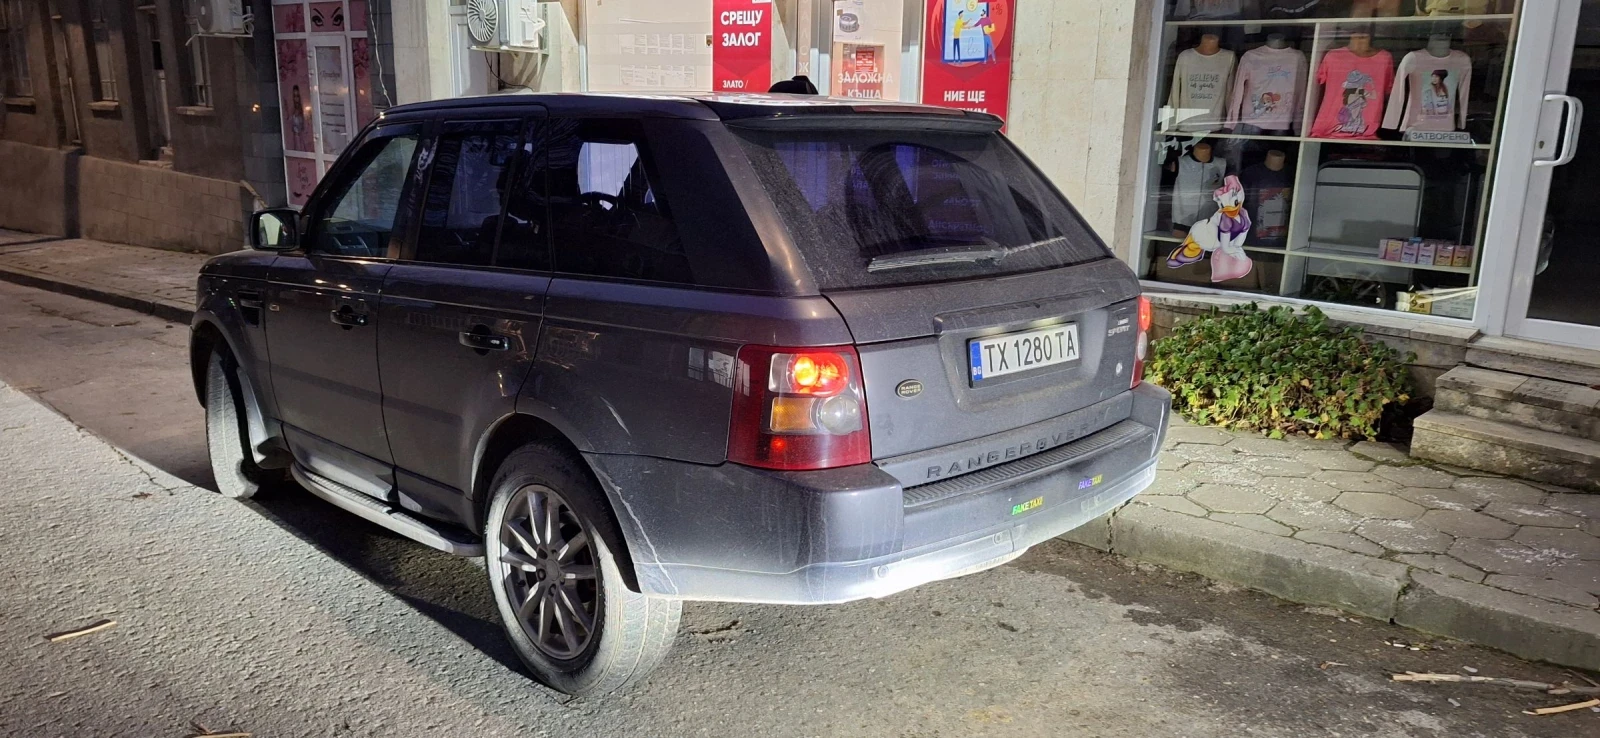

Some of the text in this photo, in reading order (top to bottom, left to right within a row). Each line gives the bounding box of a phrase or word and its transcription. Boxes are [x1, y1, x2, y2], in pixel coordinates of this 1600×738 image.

[720, 9, 763, 27] СРЕЩУ
[721, 32, 762, 47] ЗАЛОГ
[837, 71, 893, 84] ЗАЛОЖНА
[722, 80, 744, 89] ЗЛАТО
[943, 90, 986, 104] НИЕ ЩЕ
[1411, 131, 1470, 142] ЗАТВОРЕНО
[984, 330, 1076, 373] TX 1280 TA
[973, 366, 982, 376] BG
